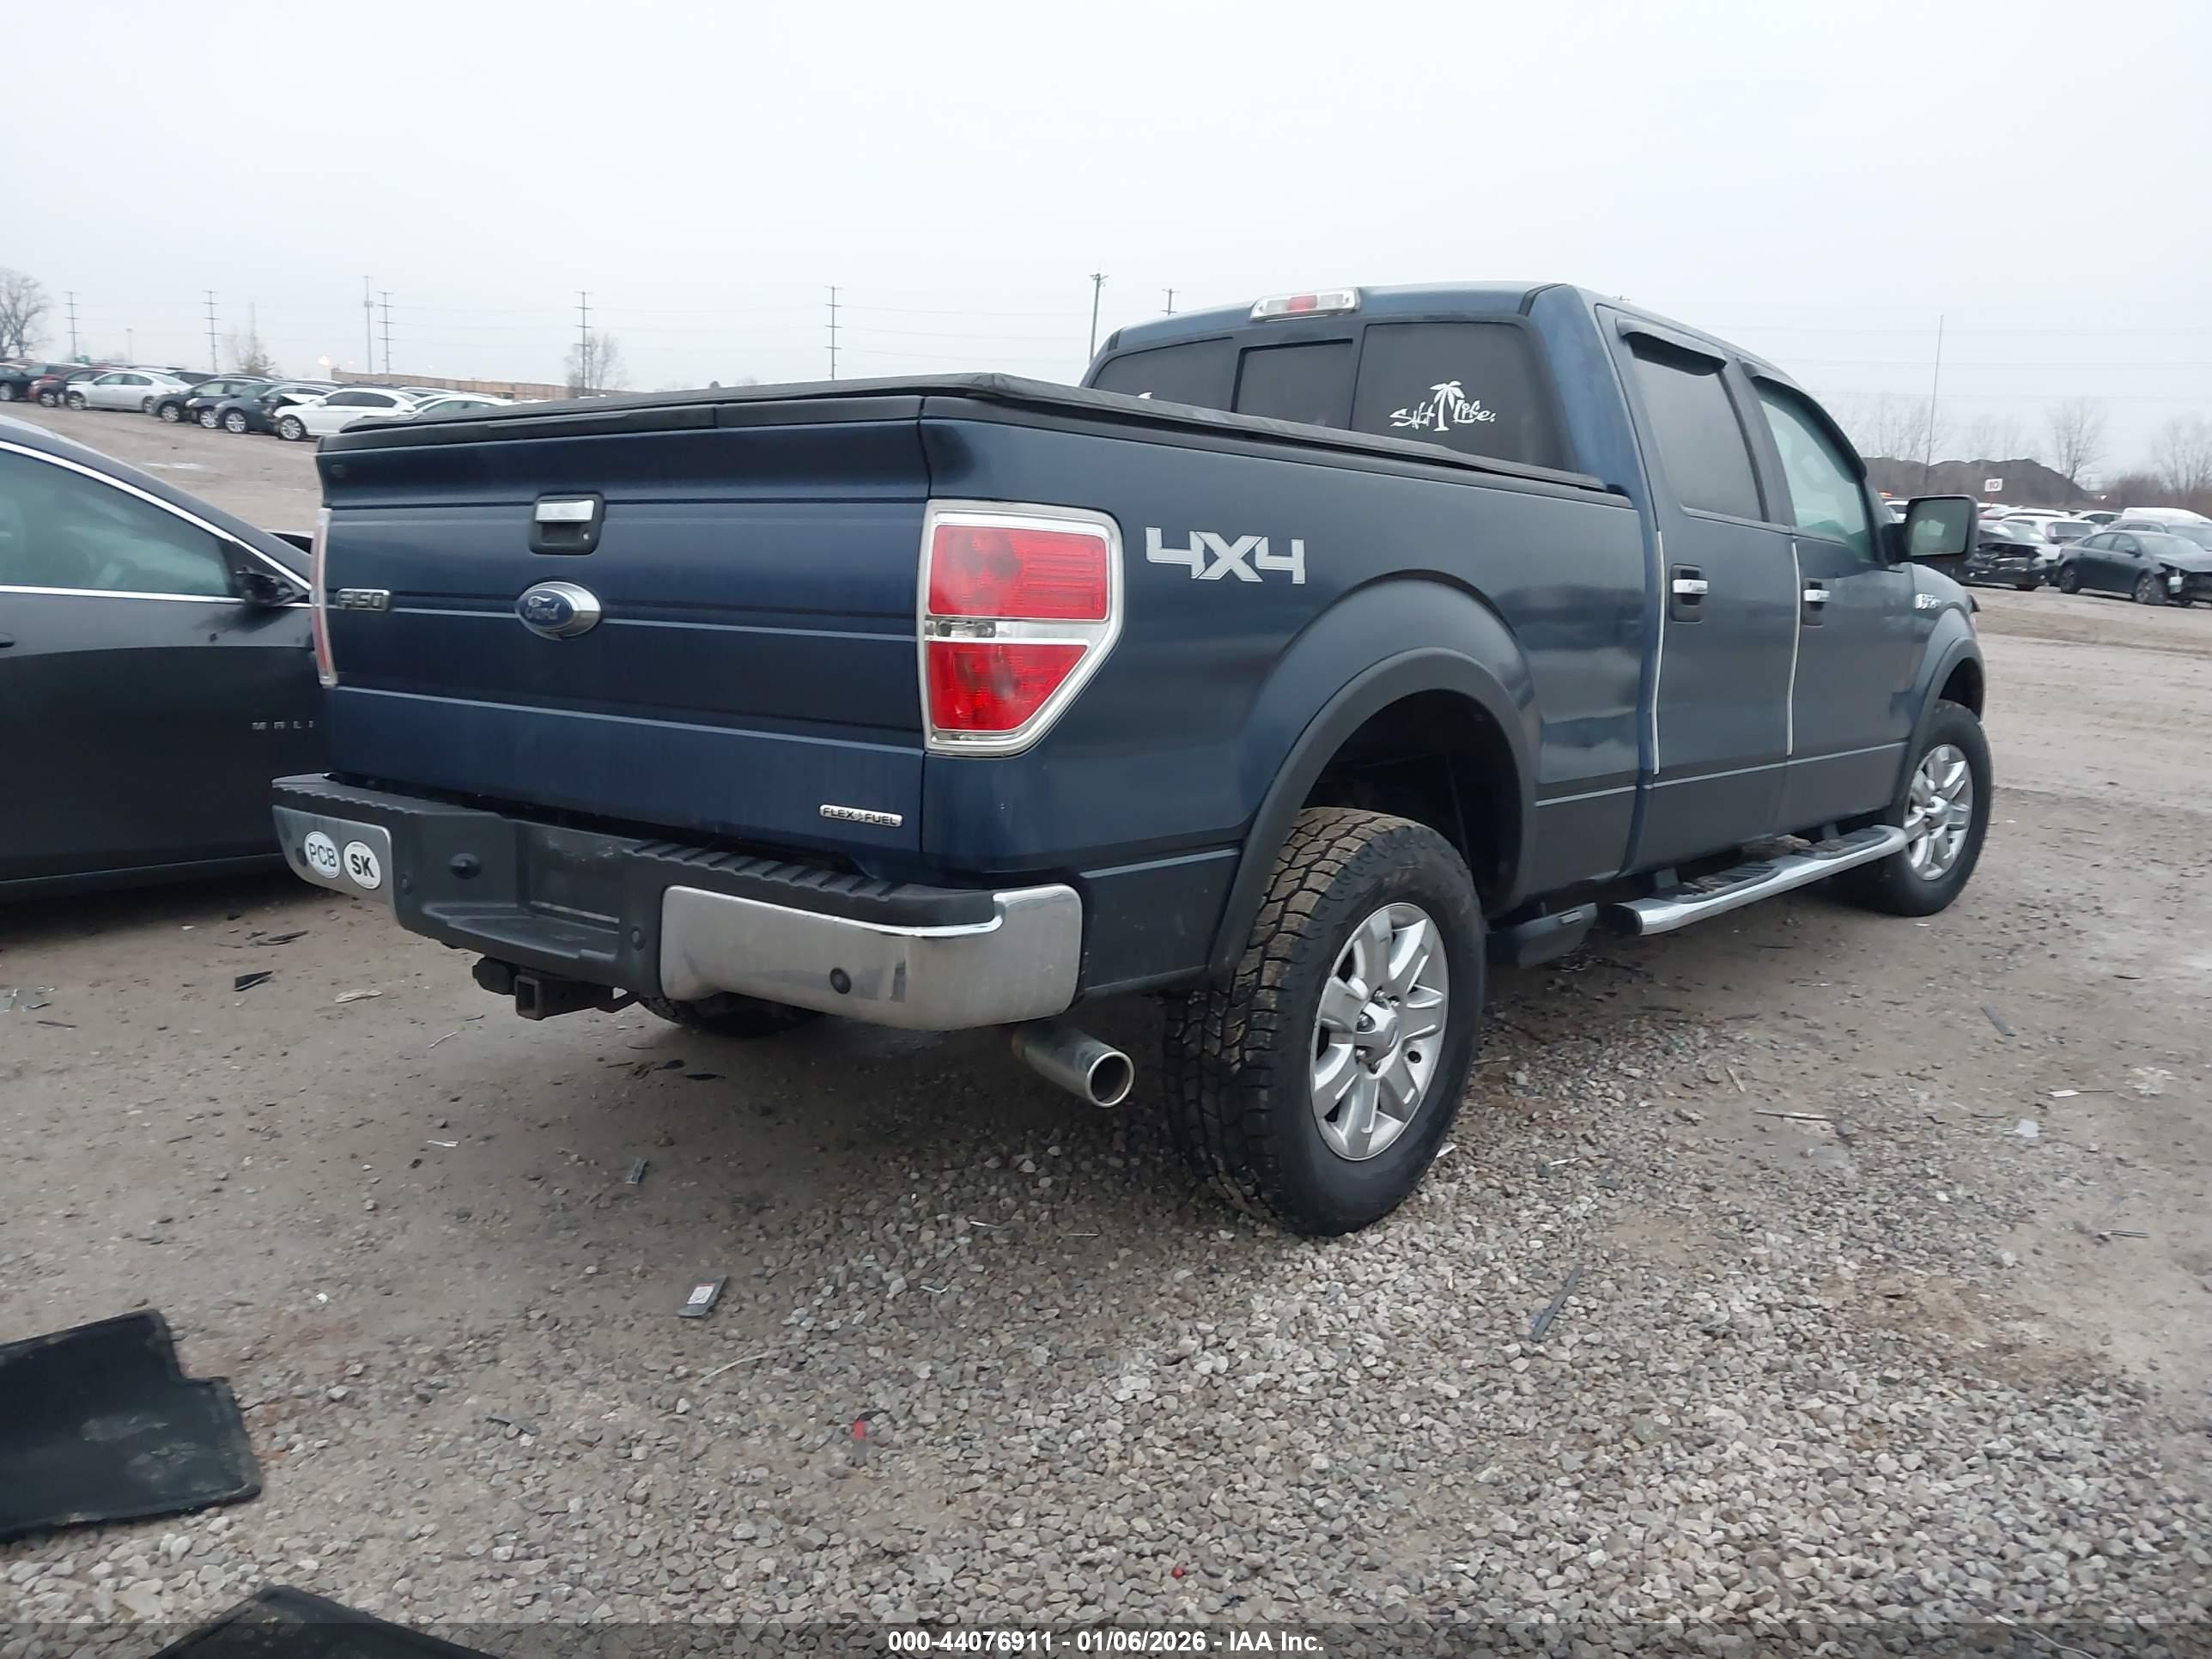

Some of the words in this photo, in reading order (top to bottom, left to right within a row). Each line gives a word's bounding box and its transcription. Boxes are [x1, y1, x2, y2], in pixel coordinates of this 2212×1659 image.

[525, 595, 561, 620] Ford
[823, 807, 854, 820] FLEX
[865, 813, 898, 825] FUEL
[308, 842, 337, 867] PCB
[350, 854, 374, 878] SK
